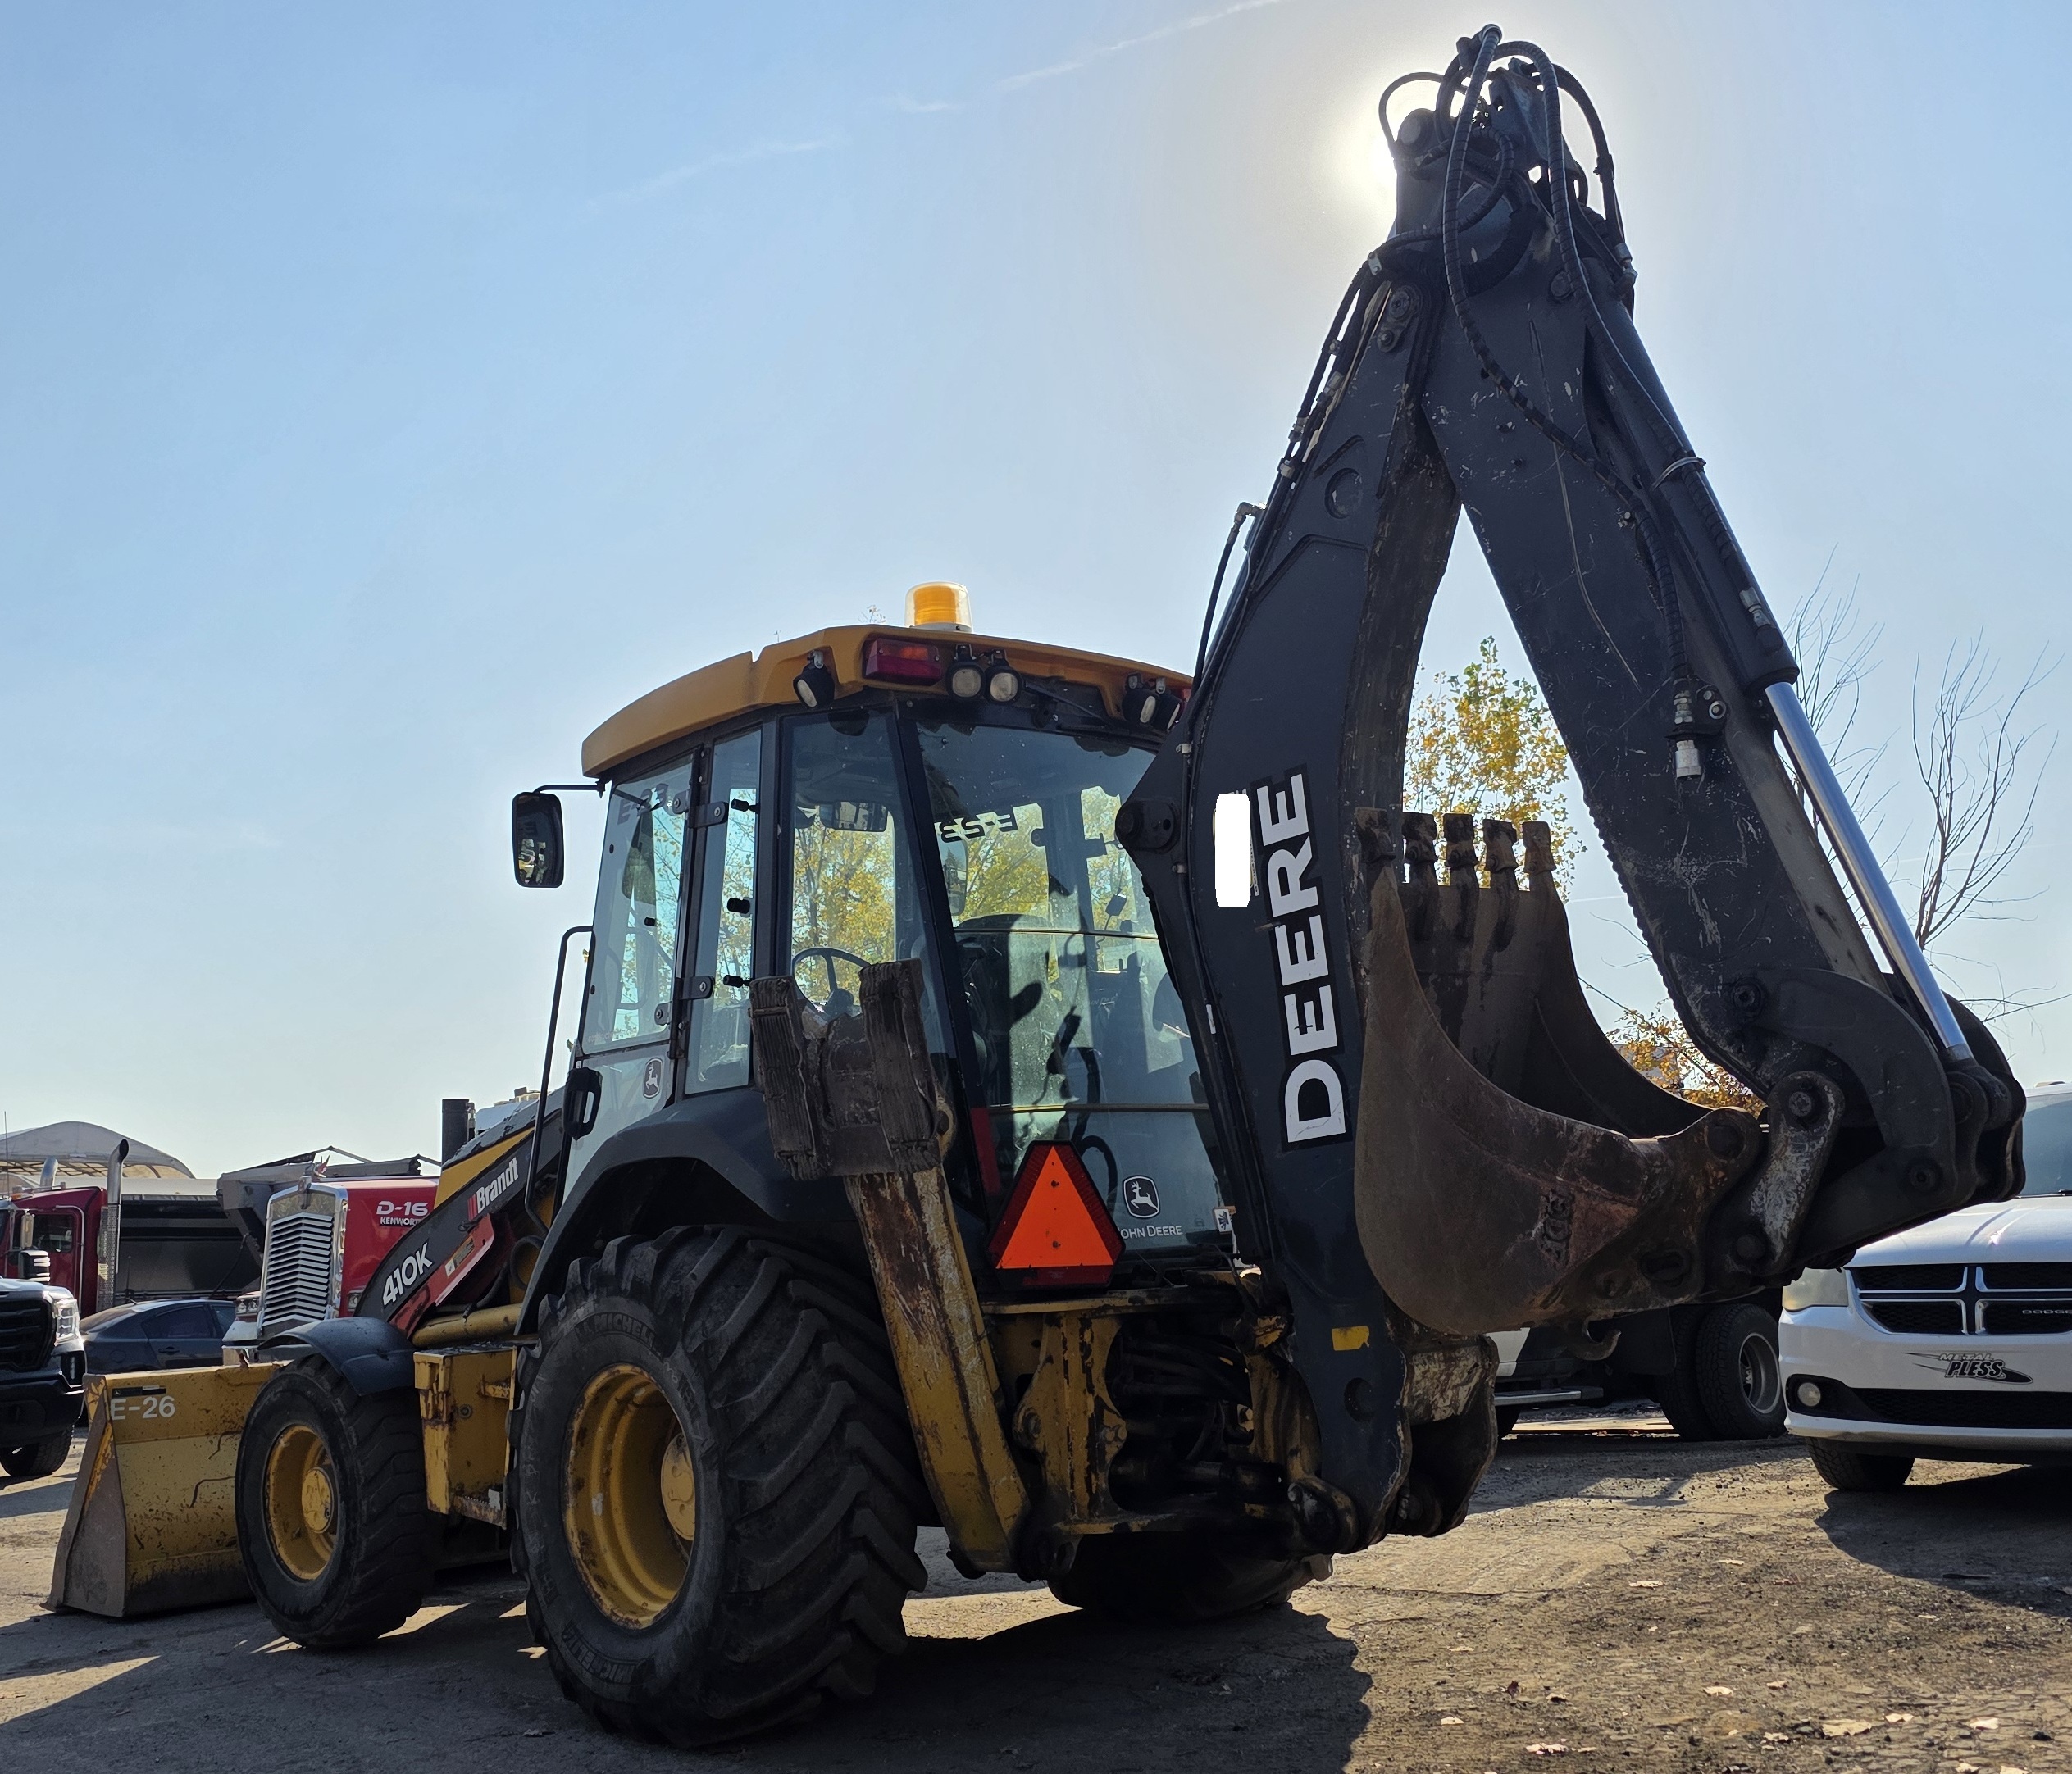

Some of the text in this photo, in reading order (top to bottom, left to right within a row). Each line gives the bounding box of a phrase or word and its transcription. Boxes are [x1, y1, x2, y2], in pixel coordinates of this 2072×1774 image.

[1257, 773, 1346, 1143] DEERE
[476, 1158, 518, 1213] Brandt
[376, 1200, 428, 1217] D-16
[1118, 1225, 1183, 1240] OHN DEERE
[382, 1242, 433, 1306] 410K
[1946, 1361, 2005, 1378] PLESS
[110, 1395, 176, 1421] E-26
